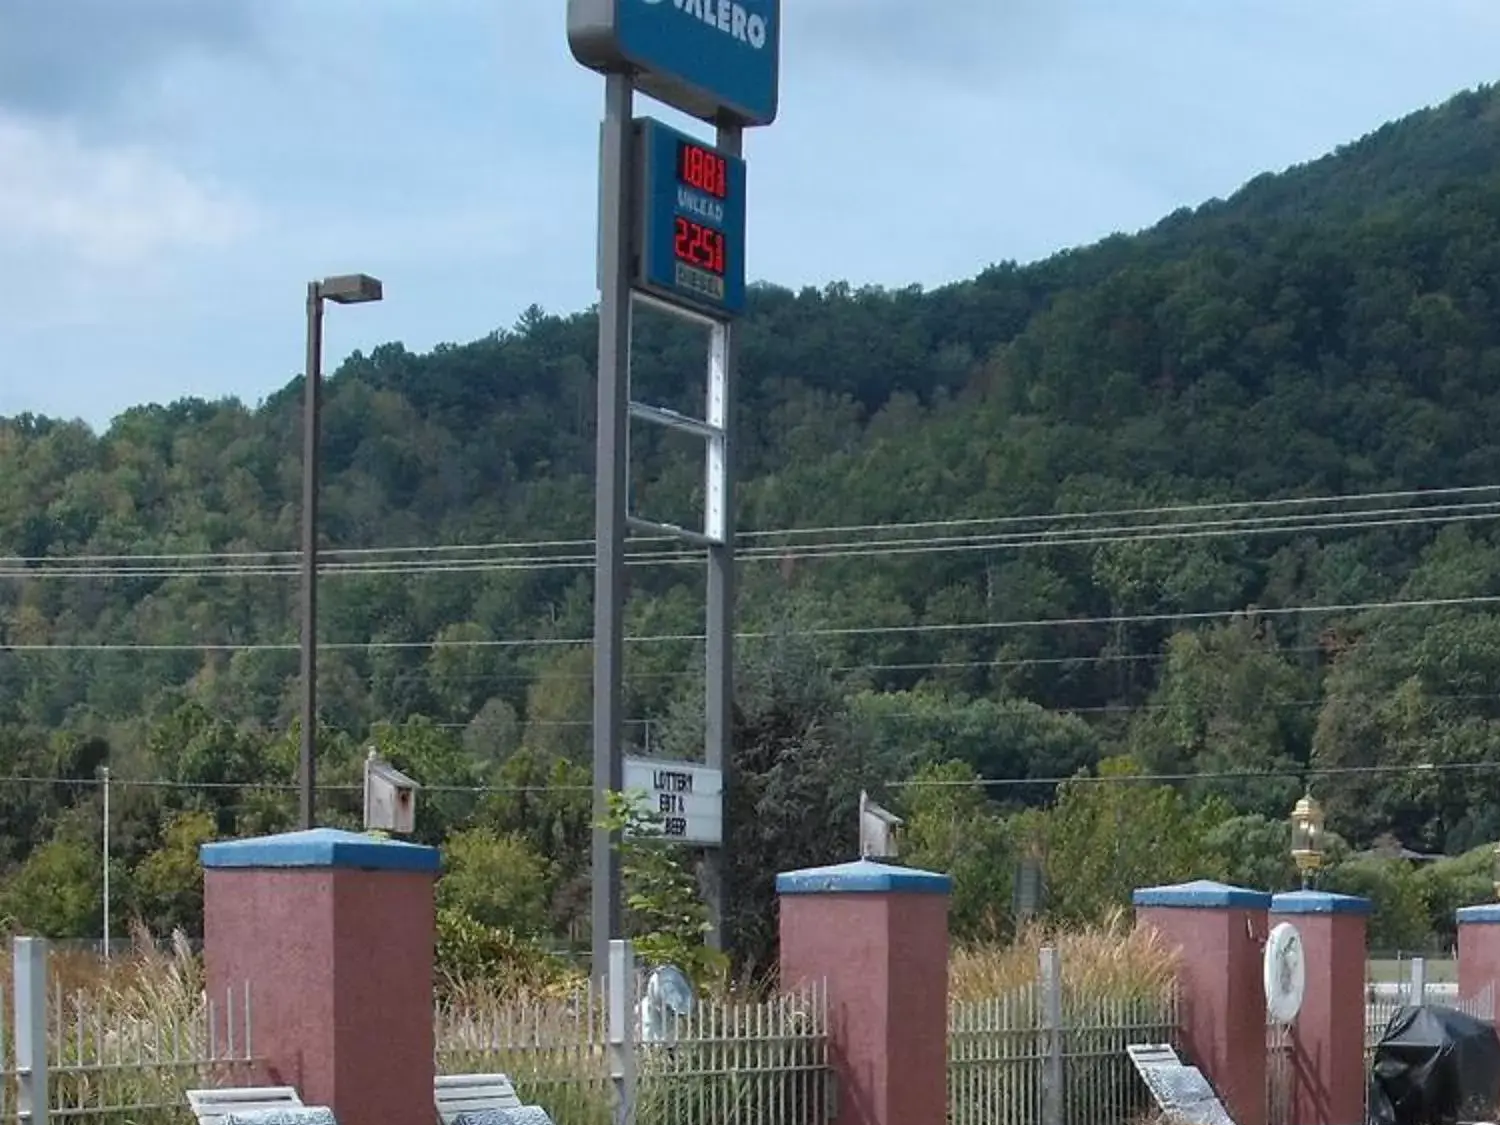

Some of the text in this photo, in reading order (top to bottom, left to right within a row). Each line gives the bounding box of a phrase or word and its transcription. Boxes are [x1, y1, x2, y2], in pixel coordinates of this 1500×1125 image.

[673, 0, 766, 48] ALERO
[653, 770, 693, 793] LOTTERY
[665, 817, 687, 836] BEER
